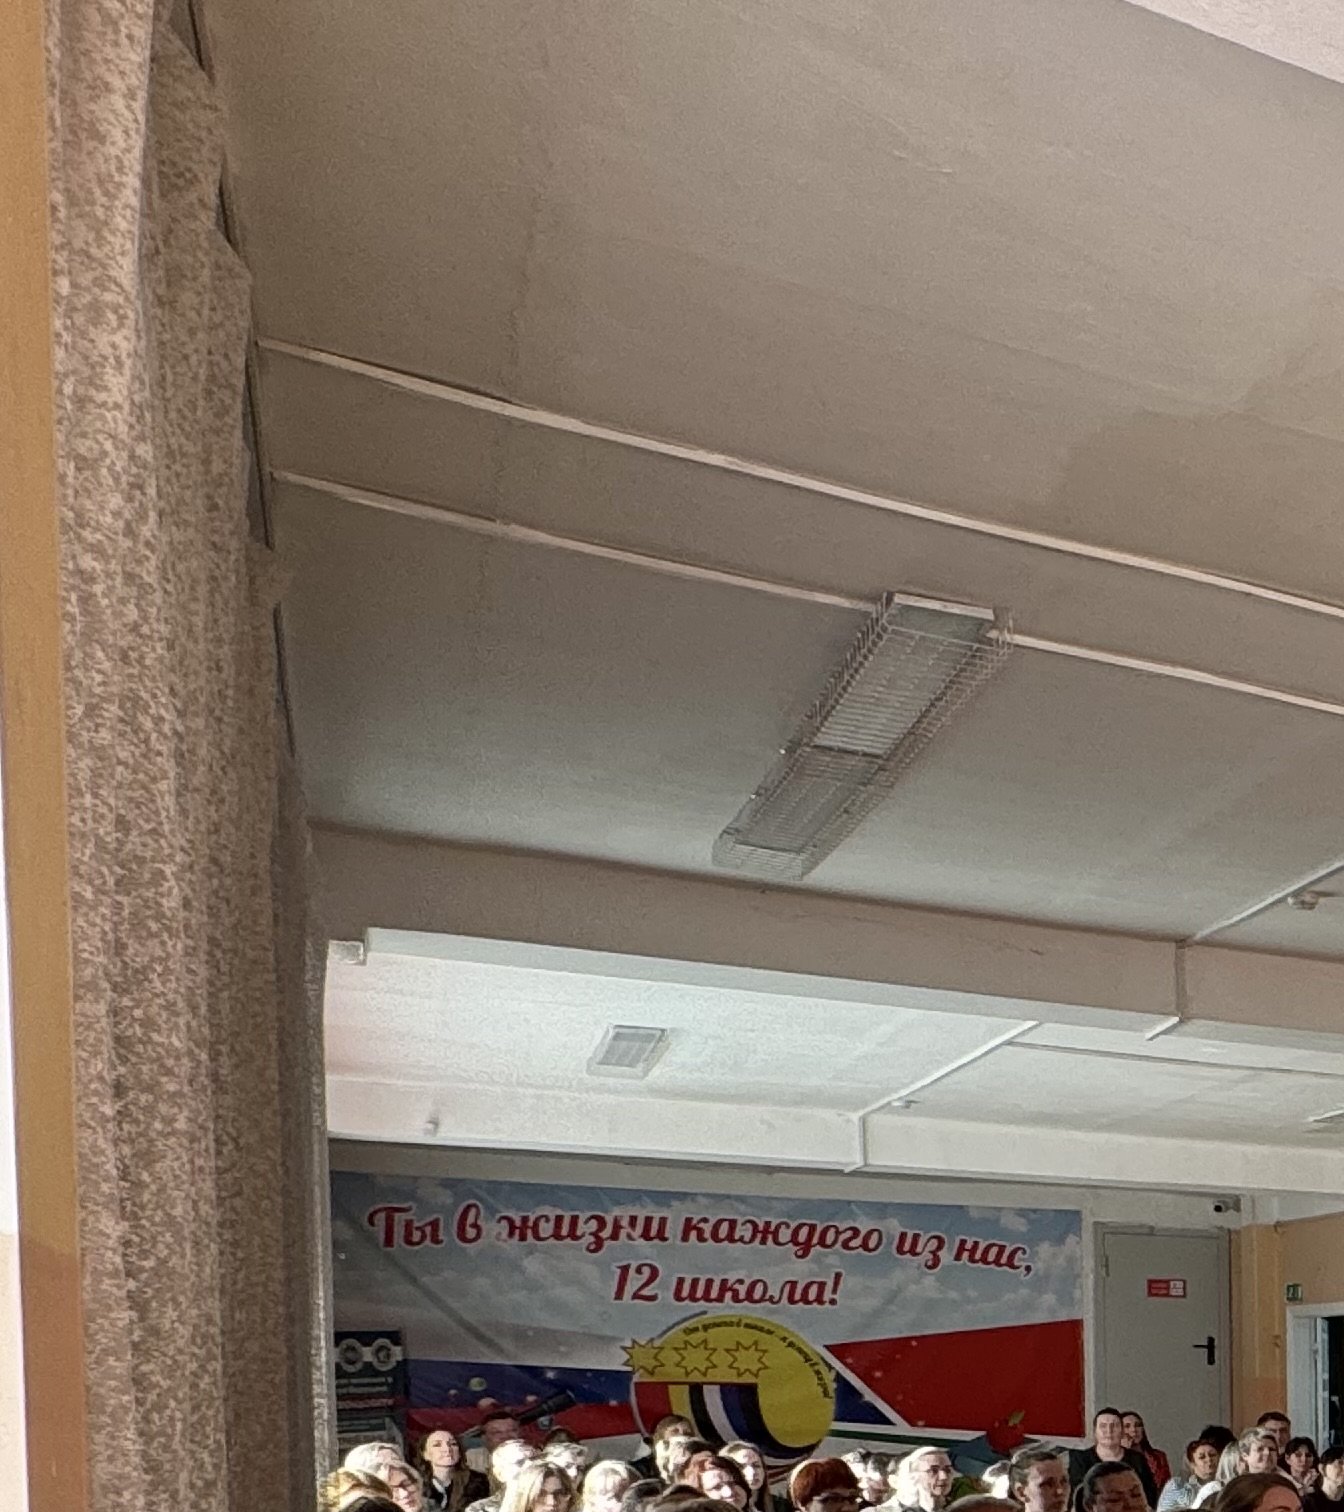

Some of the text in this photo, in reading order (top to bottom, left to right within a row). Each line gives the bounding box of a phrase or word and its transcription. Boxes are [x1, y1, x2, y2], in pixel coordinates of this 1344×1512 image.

[367, 1202, 1033, 1277] Ты в жизни каждого из нас,
[613, 1262, 843, 1305] 12 школа!
